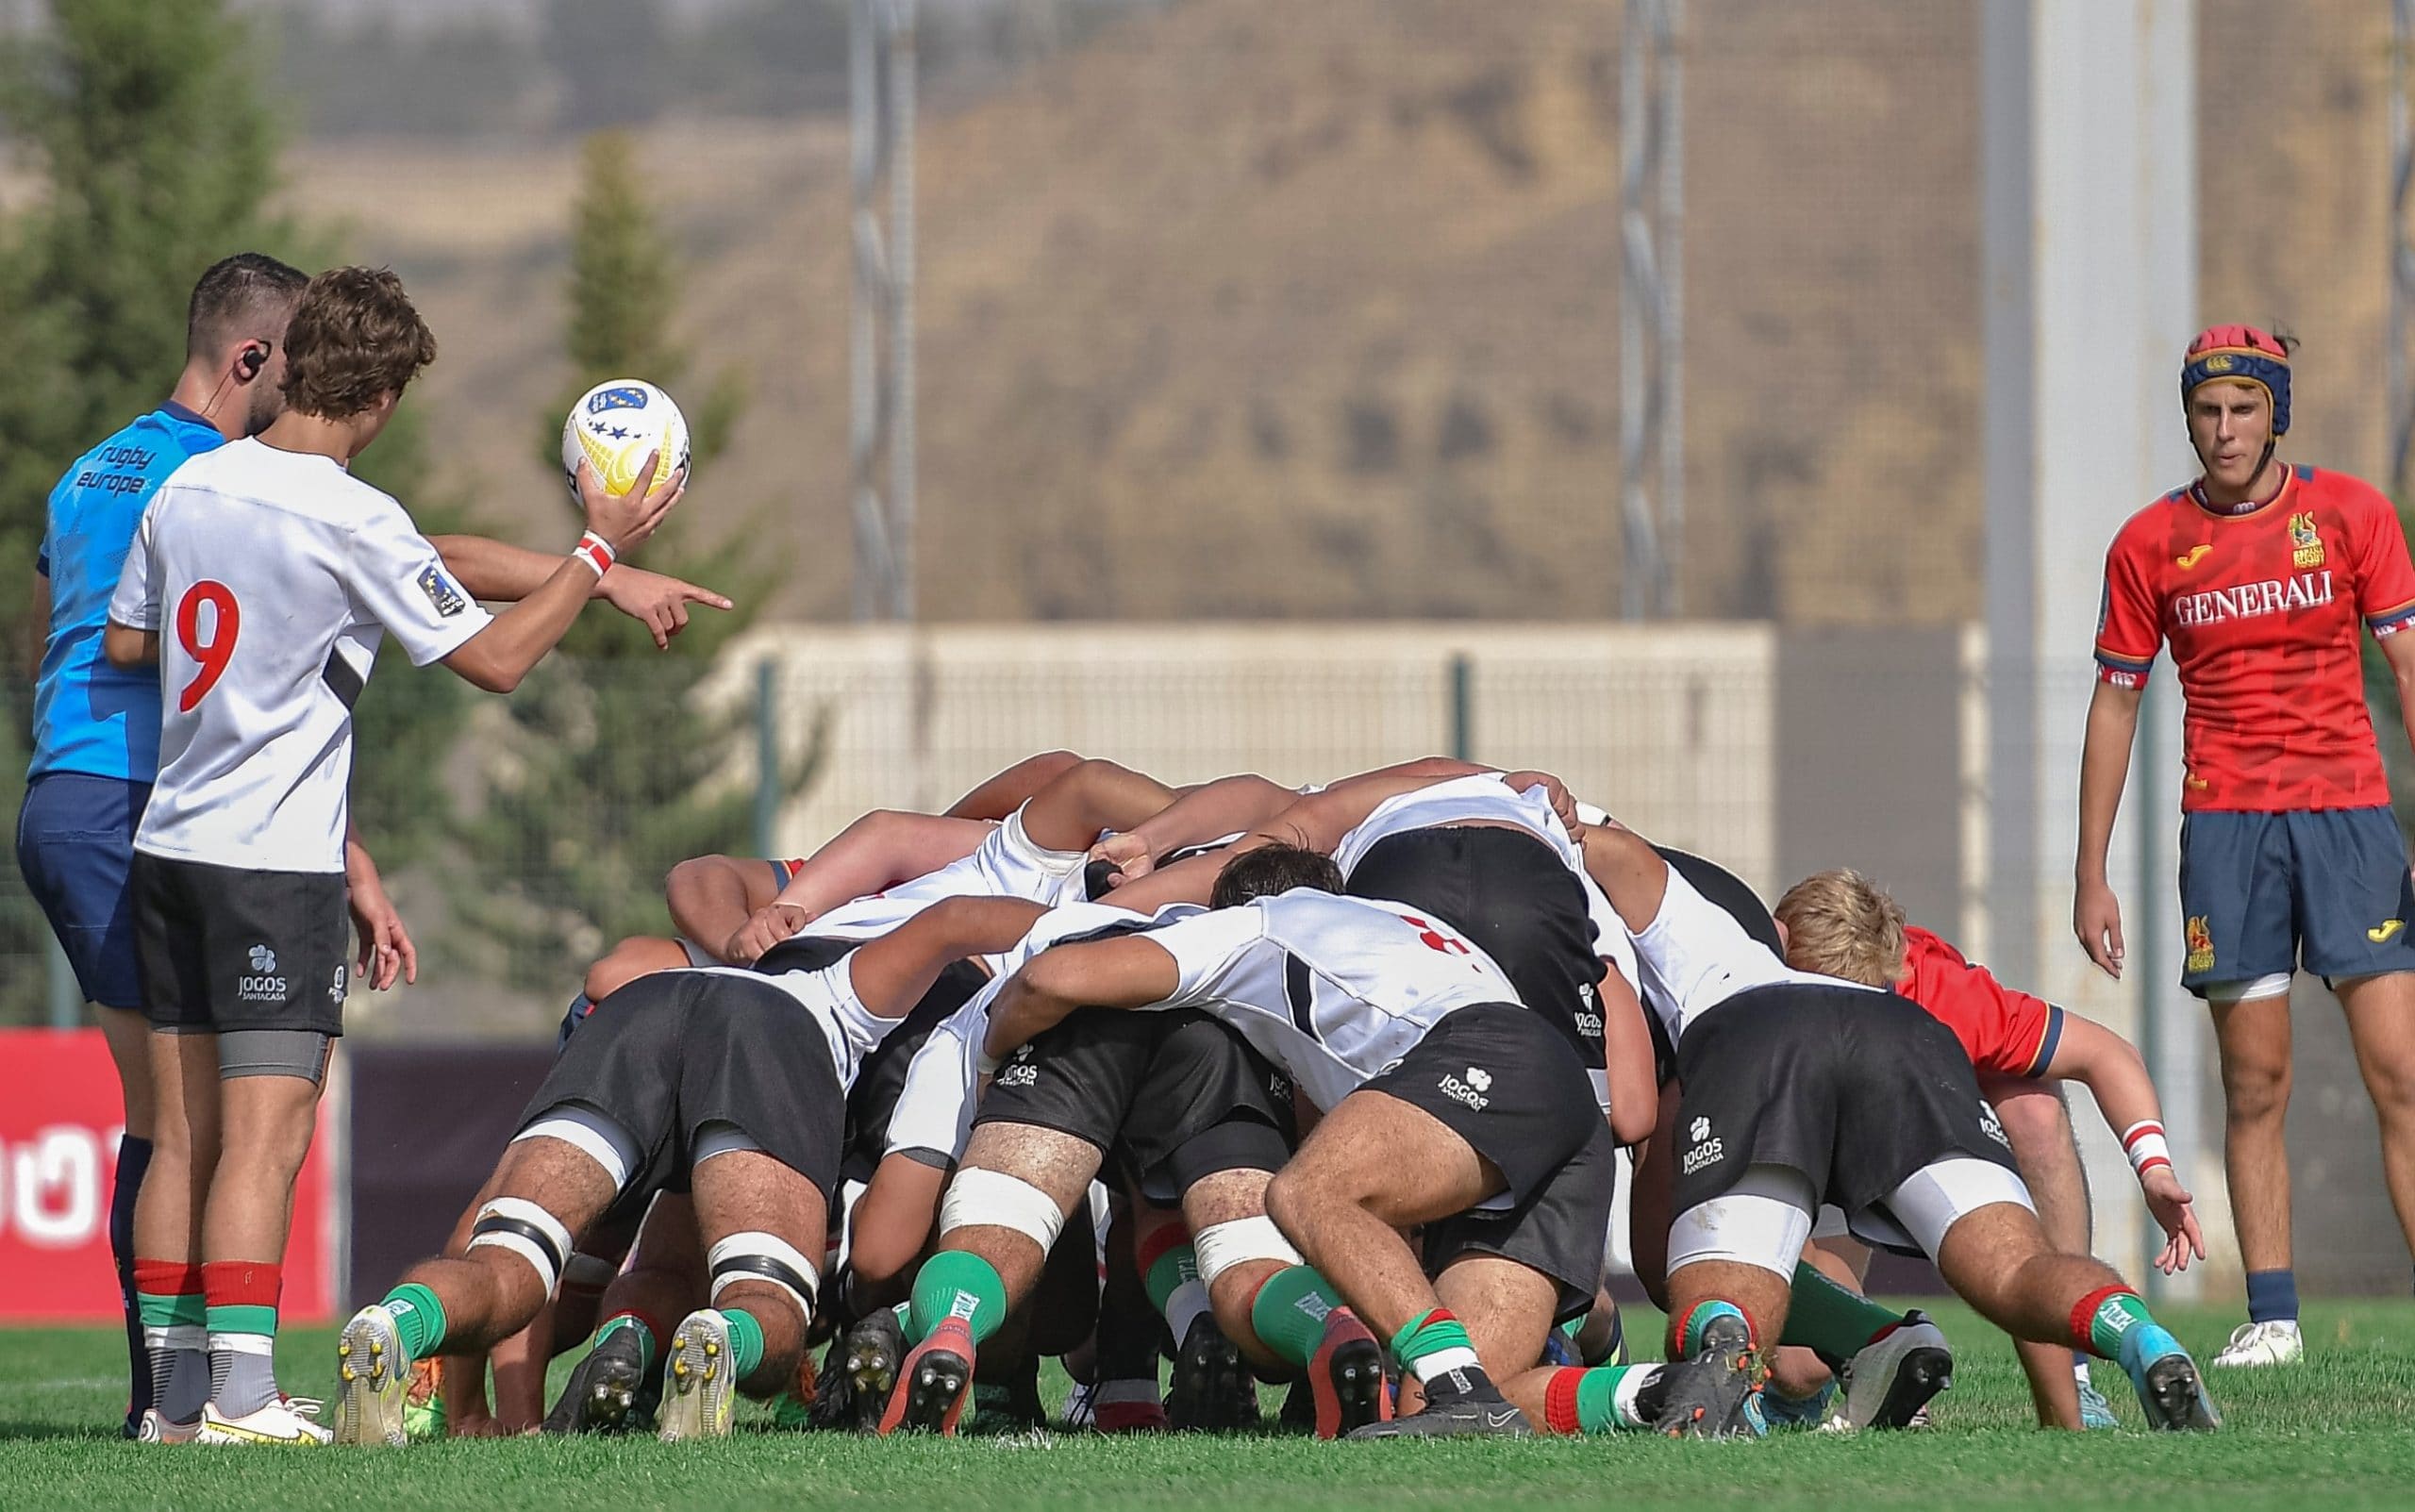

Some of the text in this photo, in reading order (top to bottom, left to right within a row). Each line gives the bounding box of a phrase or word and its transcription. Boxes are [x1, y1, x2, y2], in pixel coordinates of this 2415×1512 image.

[97, 445, 157, 471] rugby
[76, 472, 145, 498] europe
[2175, 570, 2335, 626] GENERALI
[175, 578, 242, 713] 9
[238, 976, 287, 997] JOGOS
[242, 992, 287, 1002] SANTACASA
[1683, 1137, 1723, 1174] JOGOS
